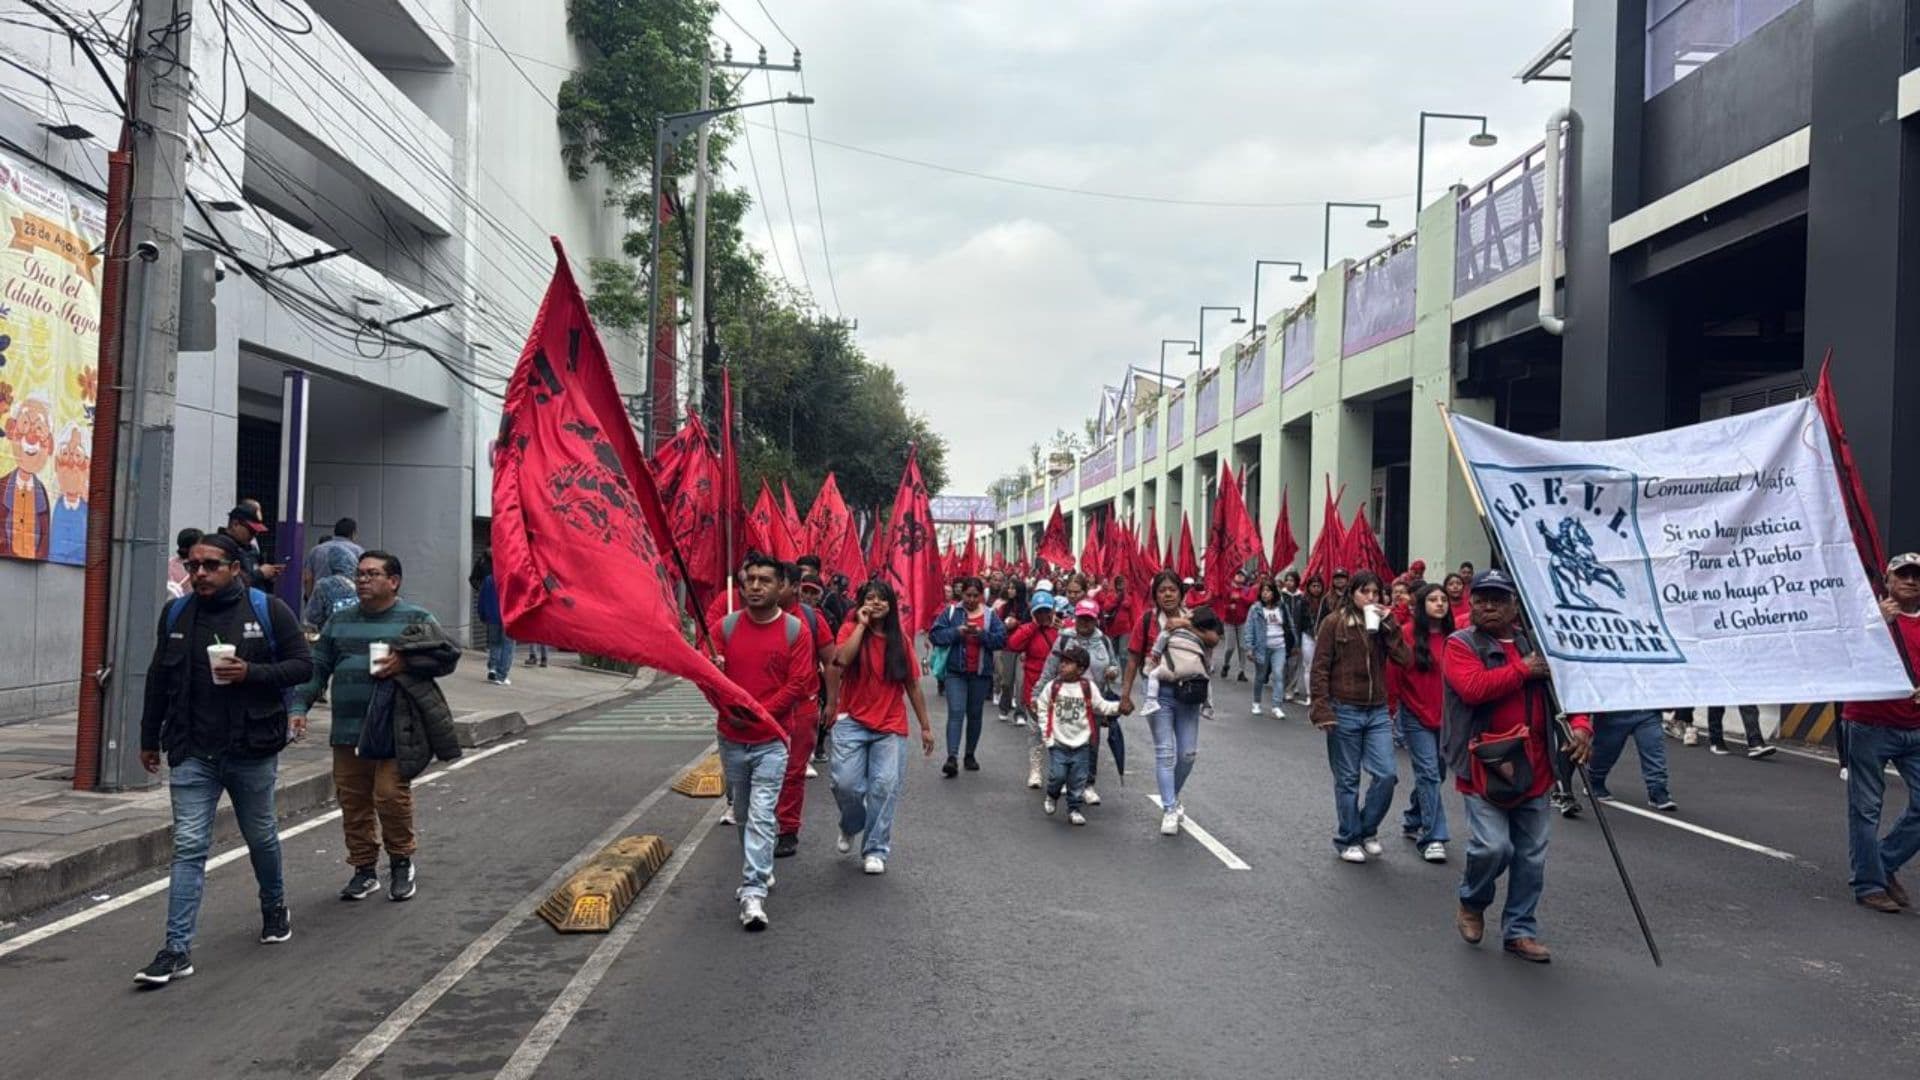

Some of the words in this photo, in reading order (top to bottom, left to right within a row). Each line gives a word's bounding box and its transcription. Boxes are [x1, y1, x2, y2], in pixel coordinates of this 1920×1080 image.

[24, 221, 36, 236] 28
[38, 226, 51, 240] de
[1643, 472, 1742, 499] Comunidad
[1663, 523, 1682, 542] Si
[1688, 527, 1711, 540] no
[1714, 519, 1740, 545] hay
[1739, 516, 1802, 544] justicia
[1687, 549, 1723, 570] Para
[1727, 550, 1741, 568] el
[1742, 543, 1802, 567] Pueblo
[1663, 583, 1698, 604] Que
[1702, 588, 1722, 601] no
[1724, 580, 1768, 604] haya
[1770, 574, 1805, 595] Paz
[1809, 575, 1845, 597] para
[1557, 613, 1647, 635] ACCION
[1713, 610, 1728, 631] el
[1730, 606, 1808, 630] Gobierno
[1554, 630, 1668, 652] POPULAR
